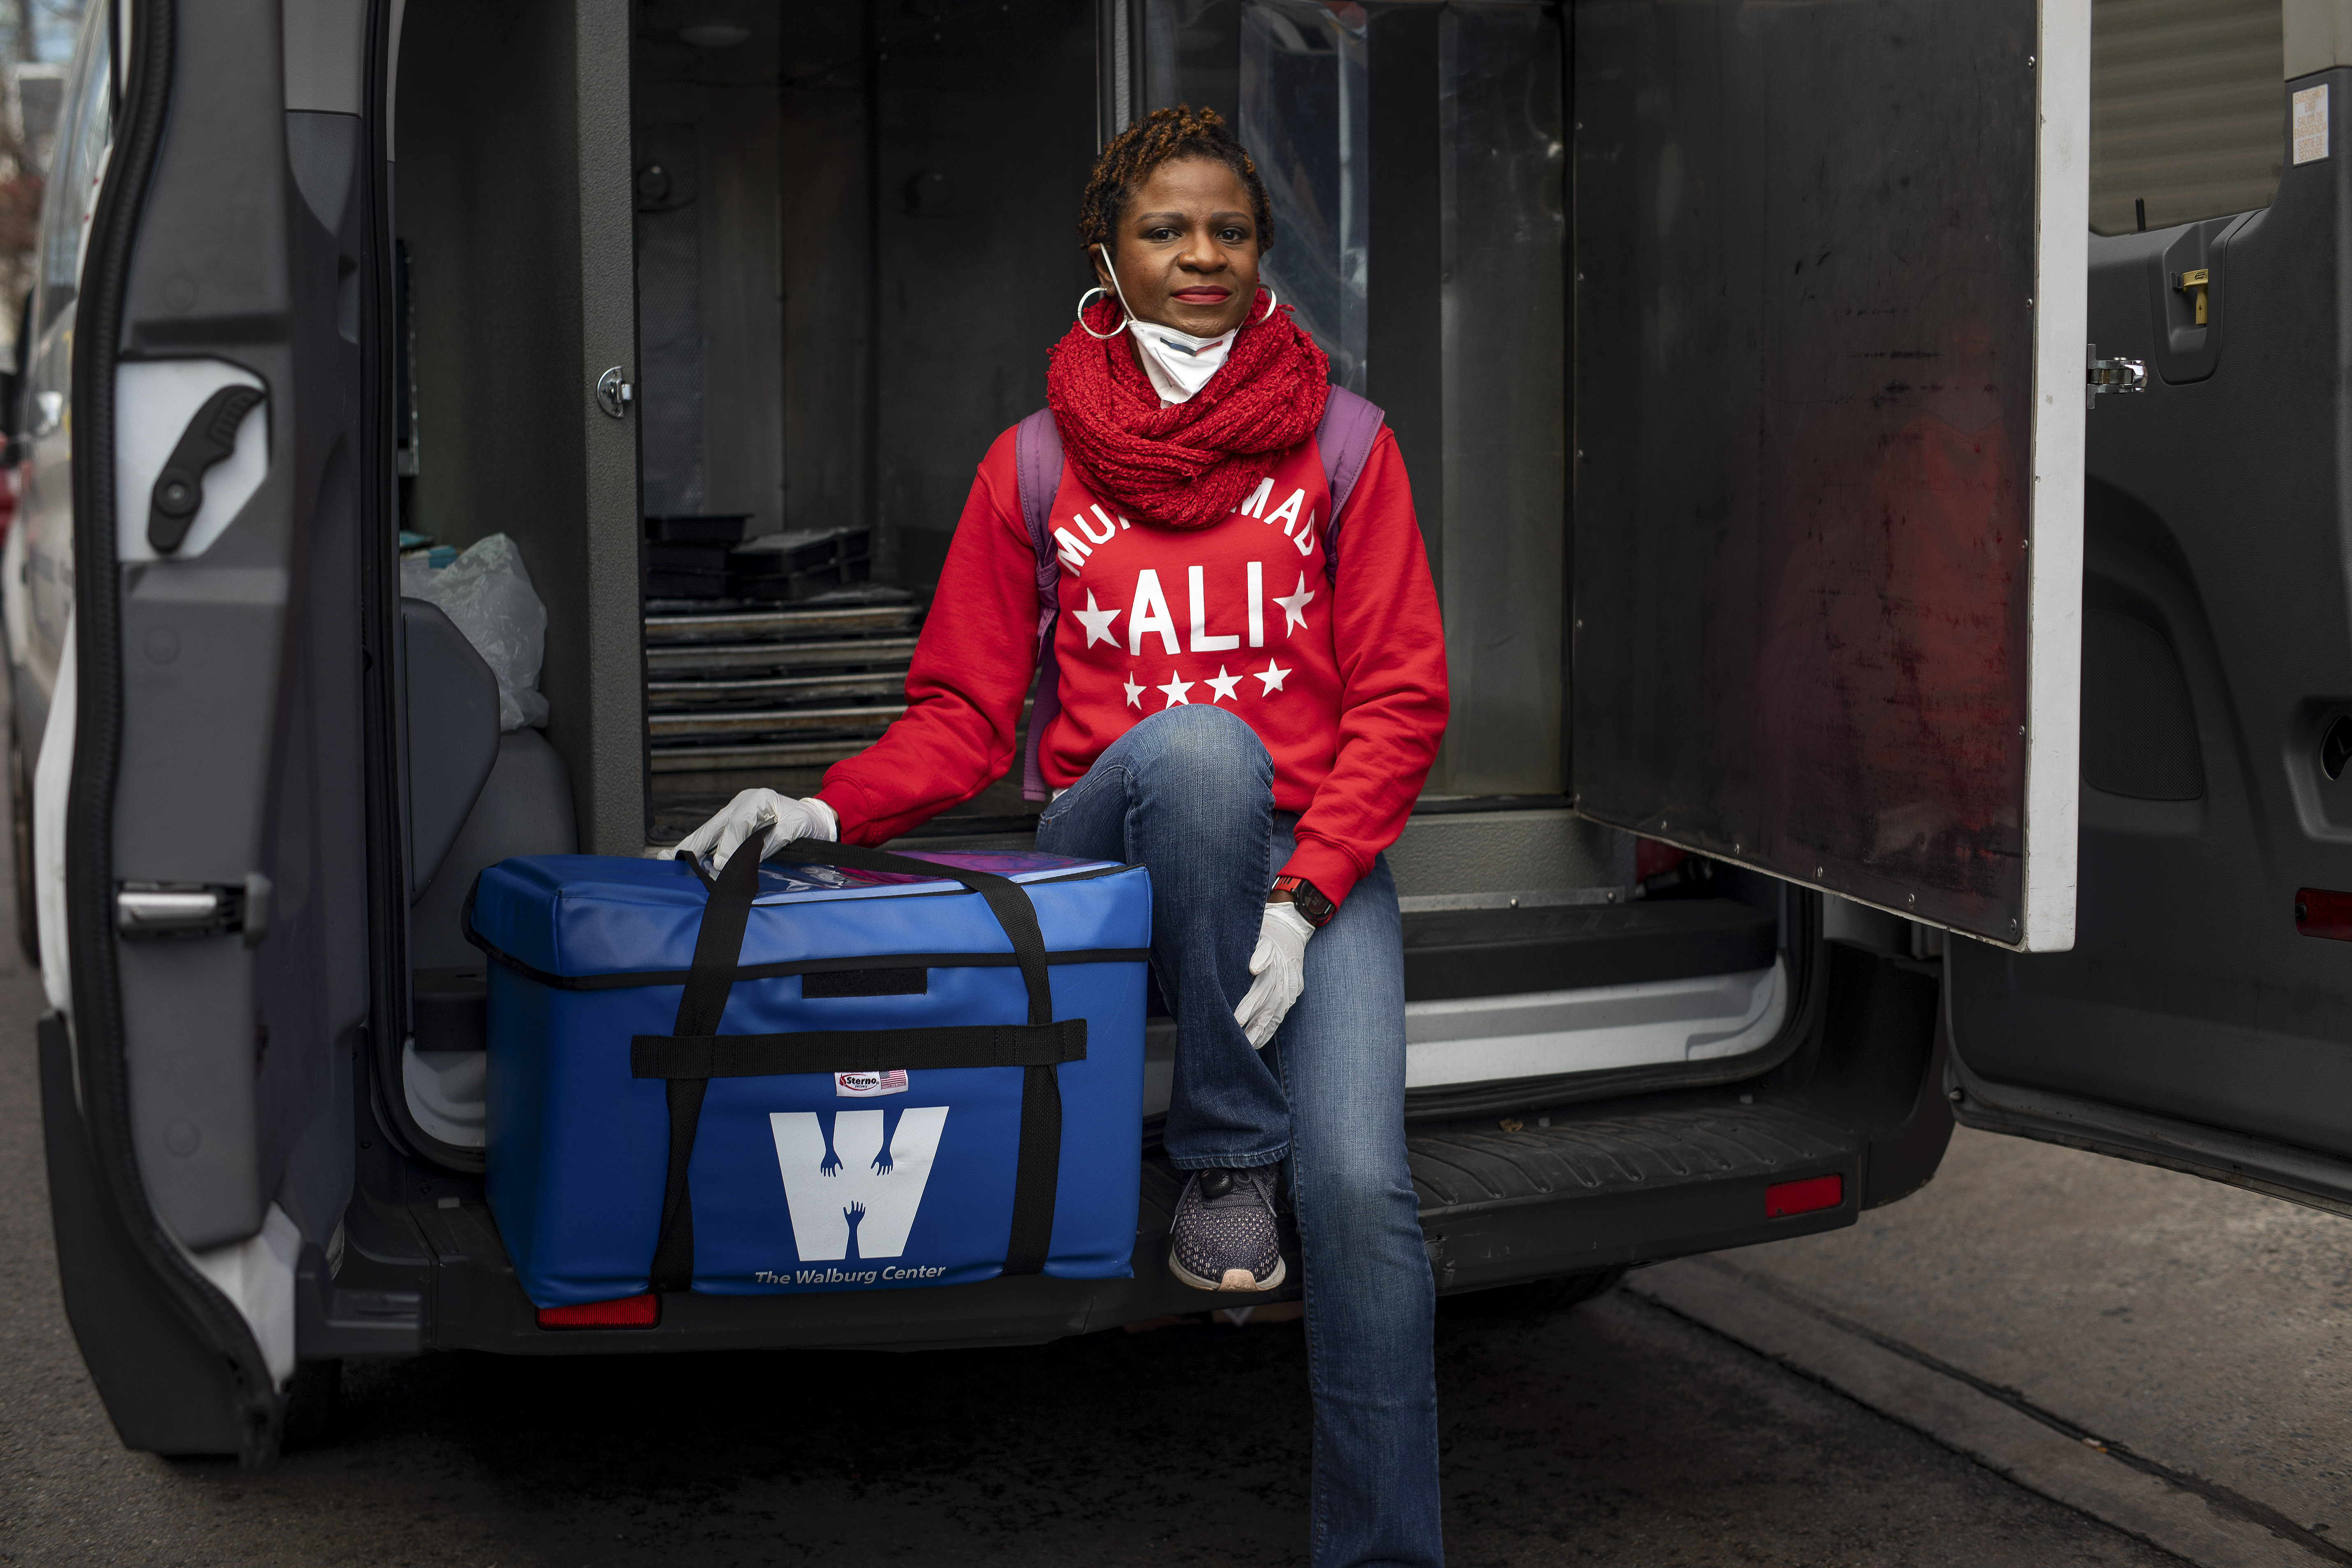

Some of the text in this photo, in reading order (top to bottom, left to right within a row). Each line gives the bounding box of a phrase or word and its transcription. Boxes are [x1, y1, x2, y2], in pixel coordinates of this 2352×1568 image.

[2316, 111, 2323, 124] DE
[2298, 135, 2323, 151] SORTIE DE
[2299, 146, 2323, 162] SECOURS
[1054, 477, 1316, 577] MUMAD
[1128, 561, 1264, 656] ALI
[755, 1265, 946, 1284] The Walburg Center
